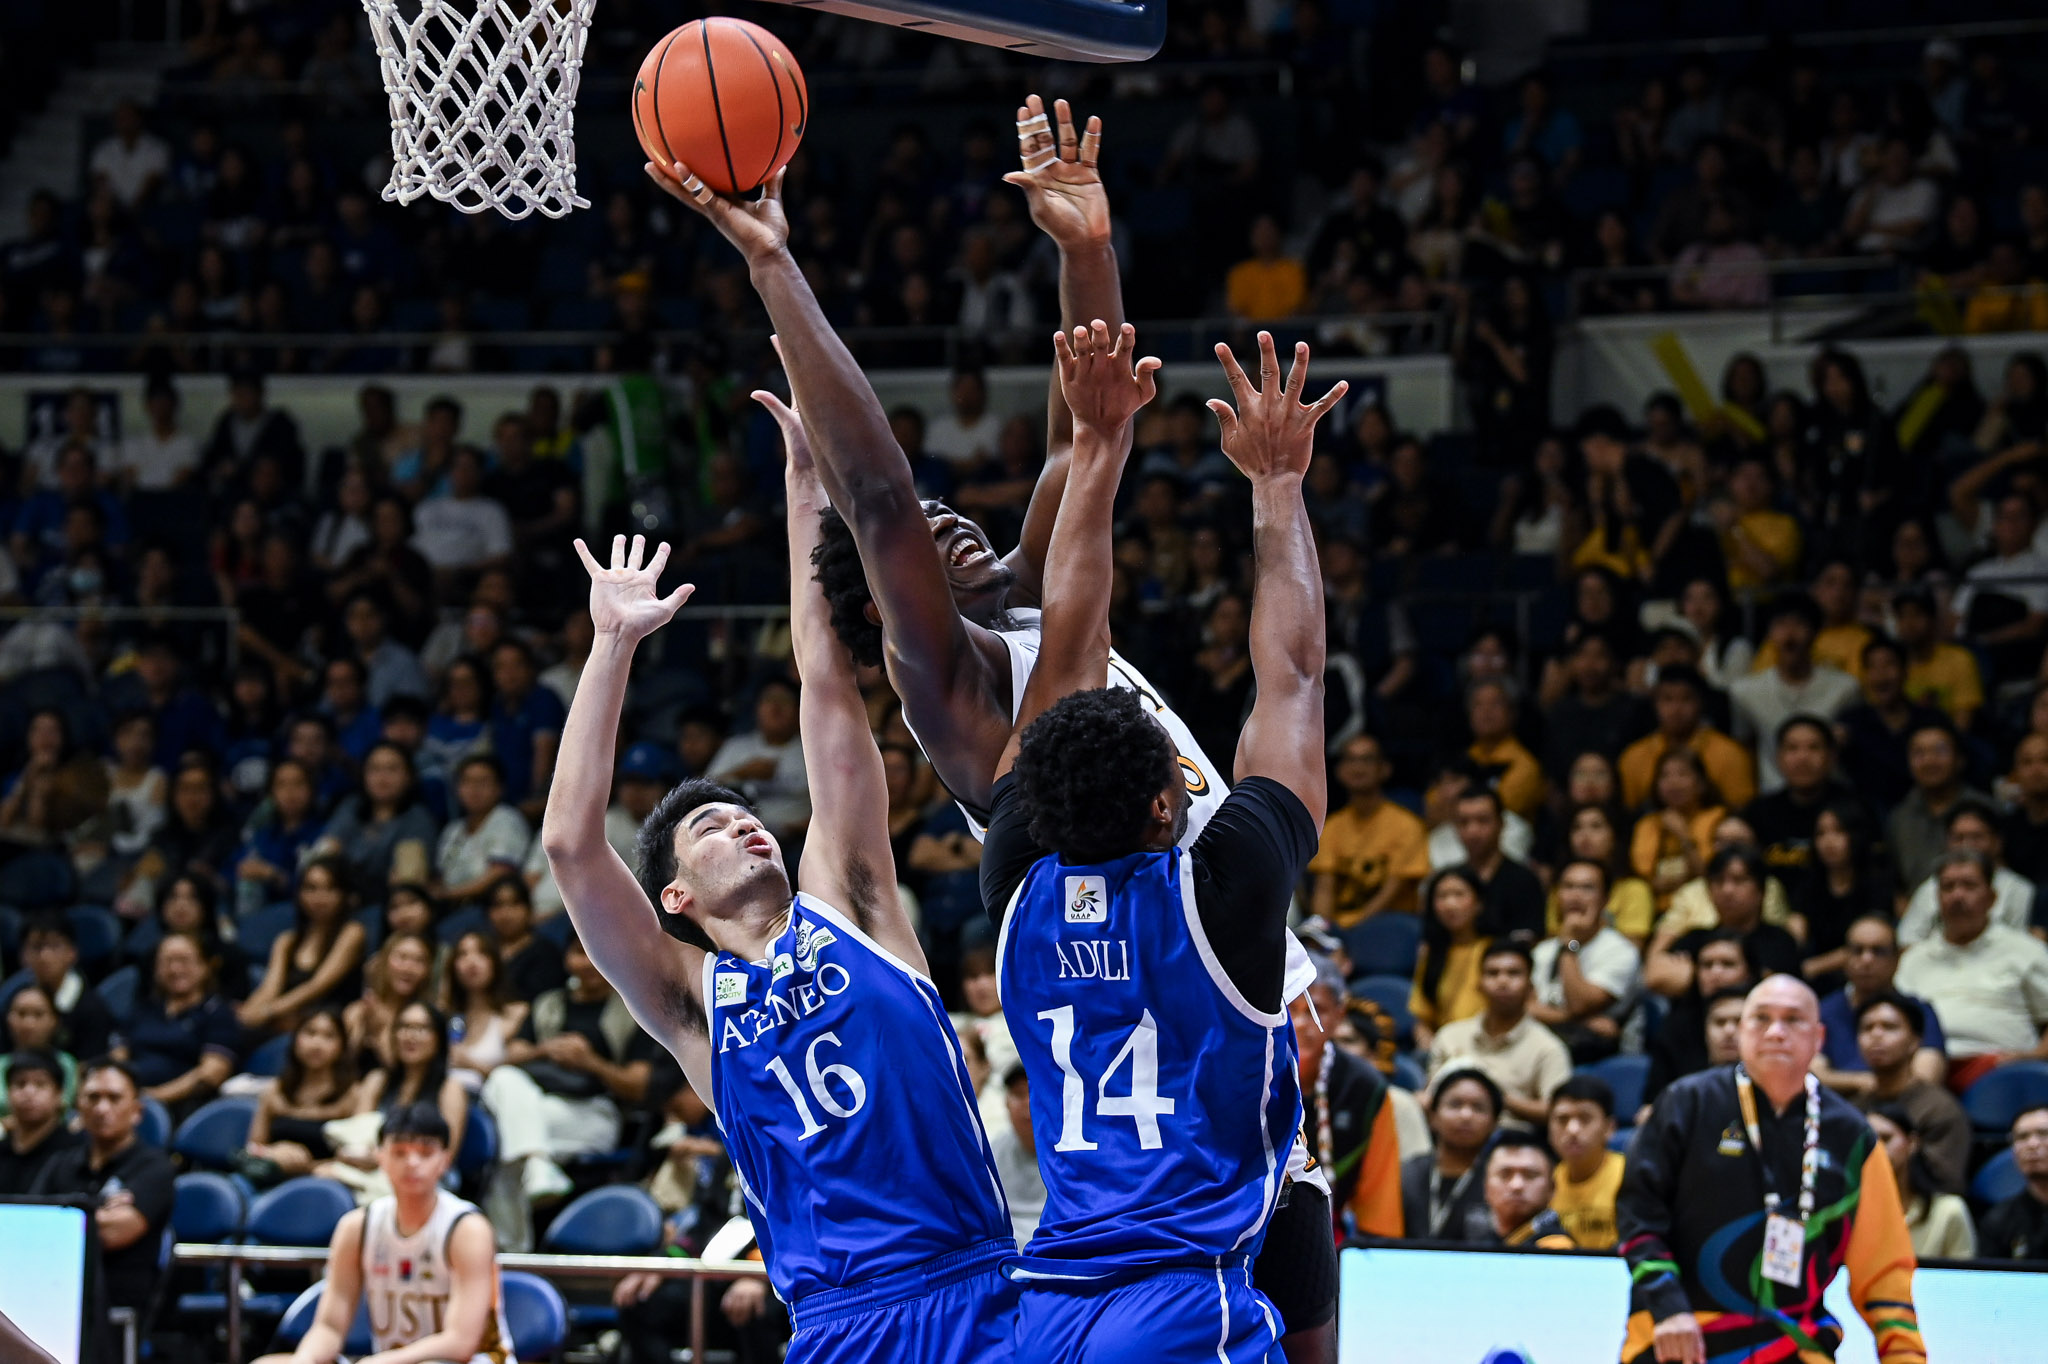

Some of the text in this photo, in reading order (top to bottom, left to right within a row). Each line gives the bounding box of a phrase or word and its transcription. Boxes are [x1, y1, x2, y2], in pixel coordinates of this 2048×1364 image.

[772, 961, 789, 976] art
[1055, 940, 1131, 981] ADILI
[719, 963, 850, 1054] ATENEO
[764, 1031, 866, 1141] 16
[1037, 1004, 1175, 1152] 14
[368, 1290, 450, 1337] UST
